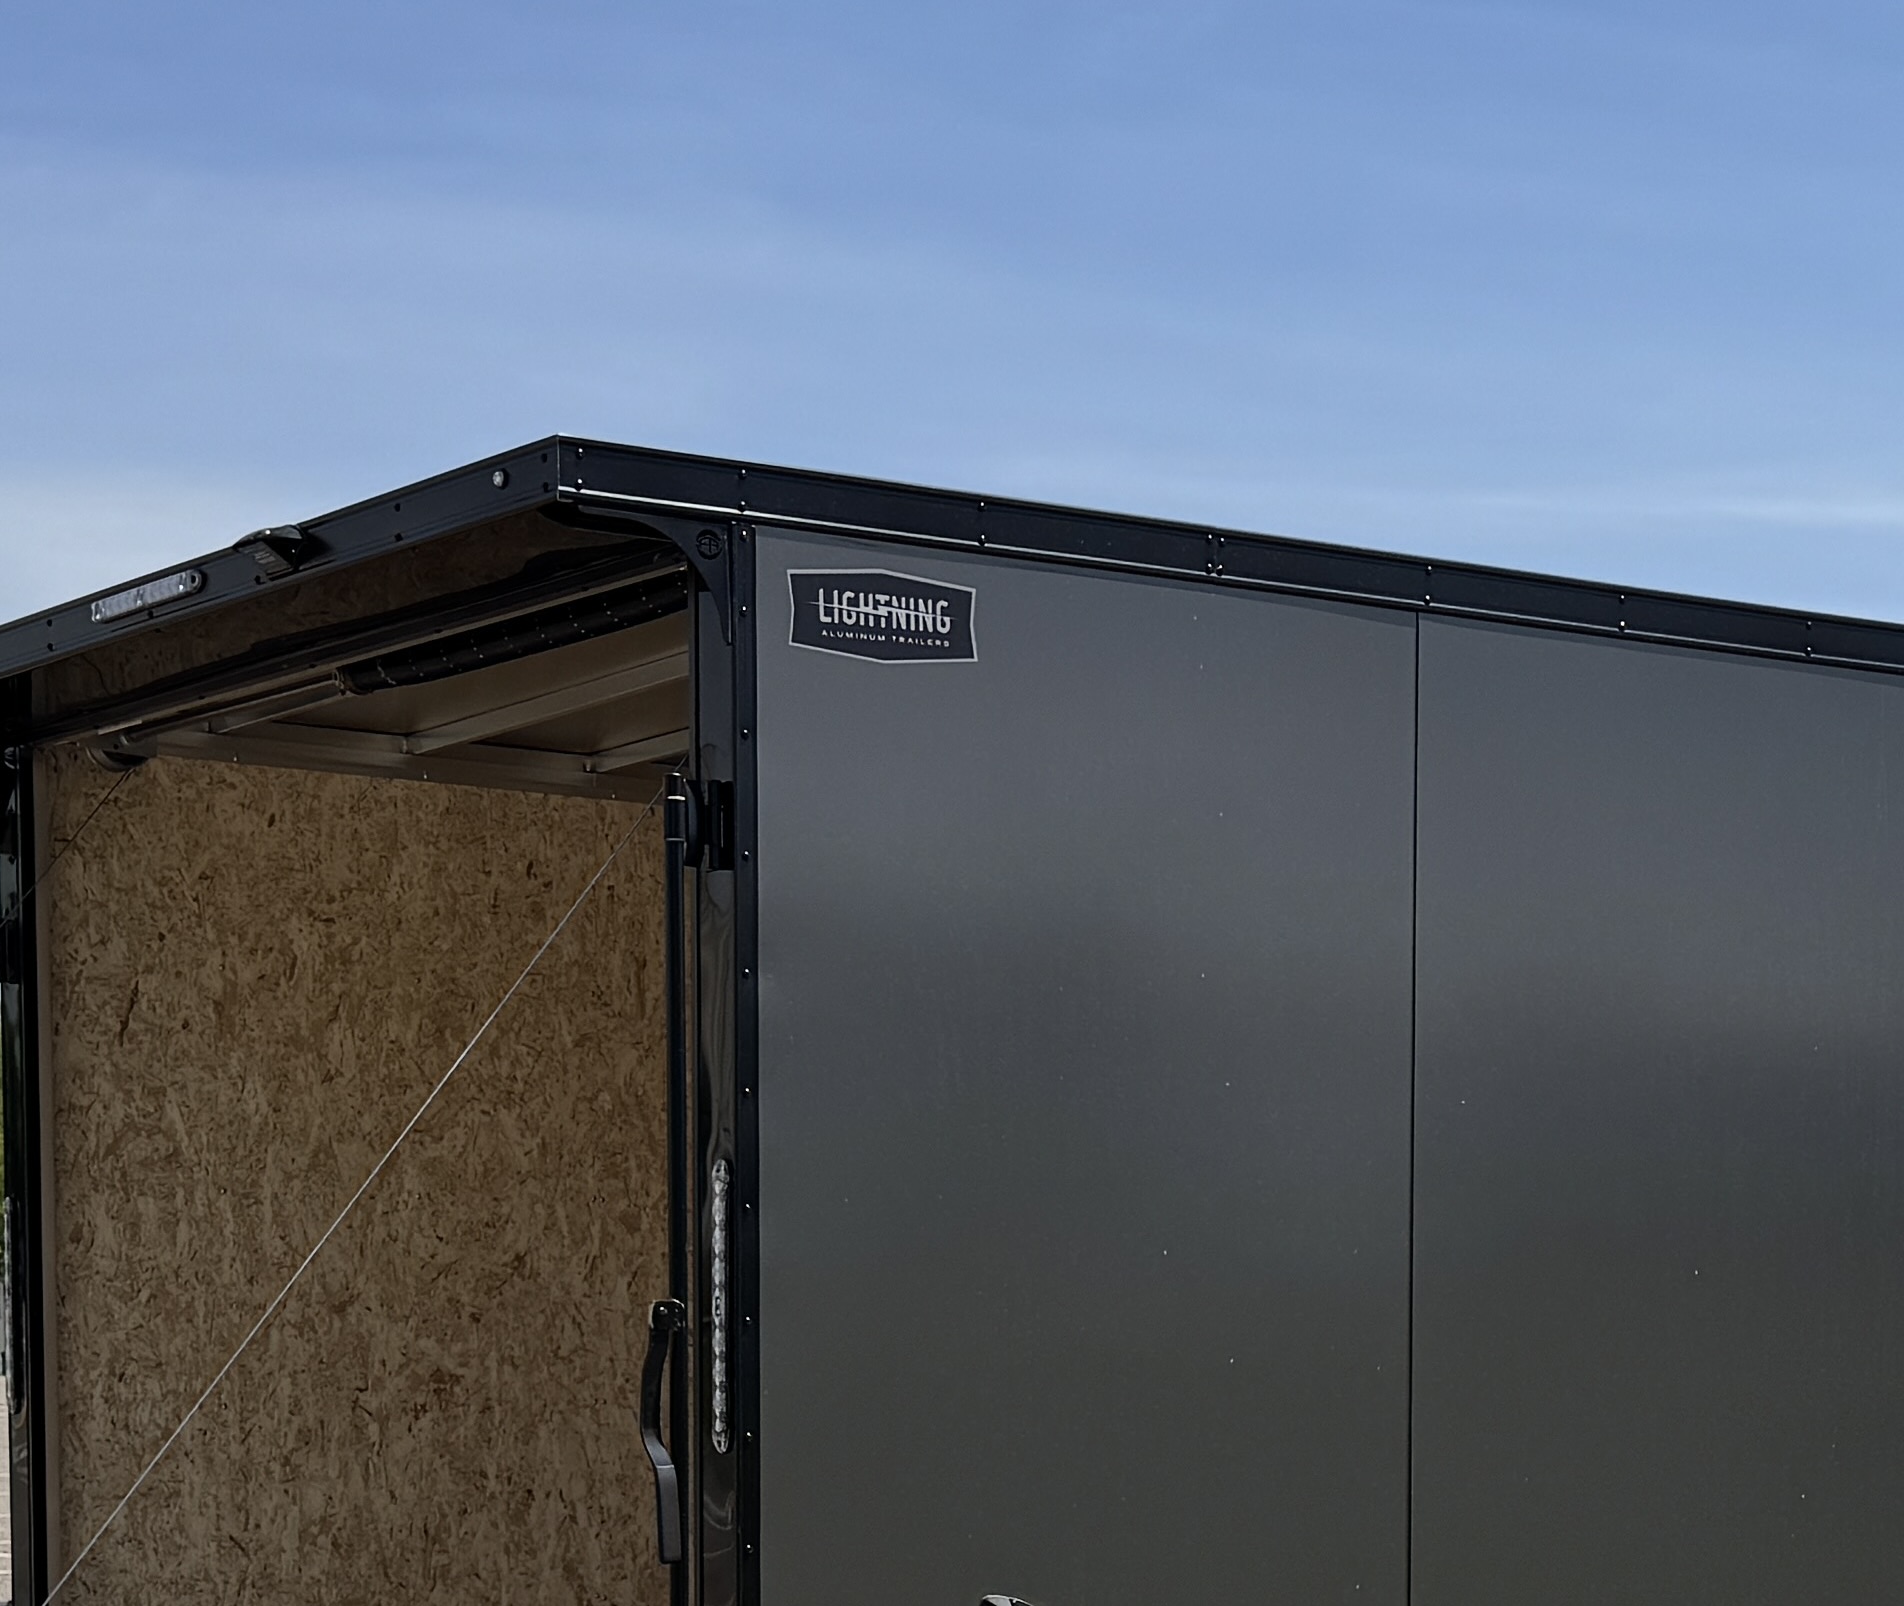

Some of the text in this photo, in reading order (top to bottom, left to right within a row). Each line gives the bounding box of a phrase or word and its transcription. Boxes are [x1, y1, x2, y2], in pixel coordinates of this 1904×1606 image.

[818, 588, 951, 634] LIGHTNING
[821, 629, 950, 648] ALUMINUM TRAILERS
